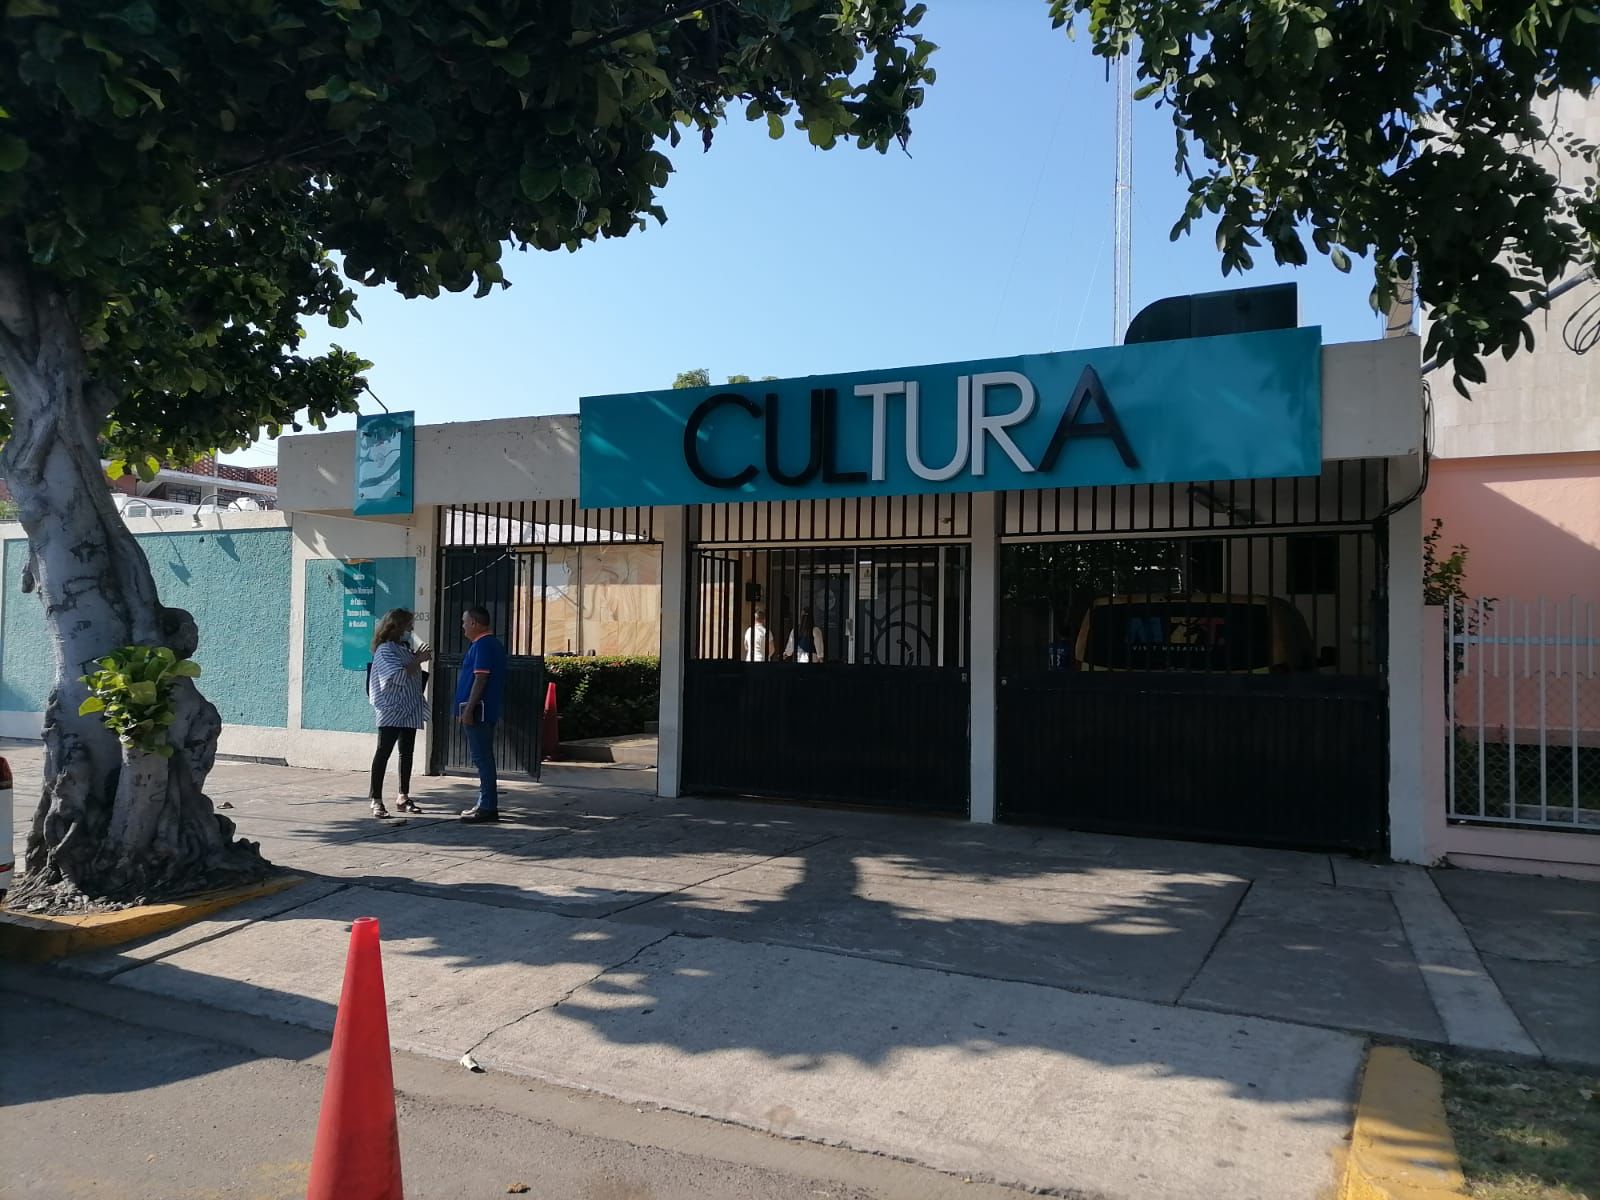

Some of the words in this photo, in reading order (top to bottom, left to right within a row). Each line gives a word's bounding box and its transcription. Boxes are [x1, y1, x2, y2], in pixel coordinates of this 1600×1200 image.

[683, 363, 1139, 490] CULTURA
[416, 543, 426, 557] 31
[415, 611, 431, 622] 203
